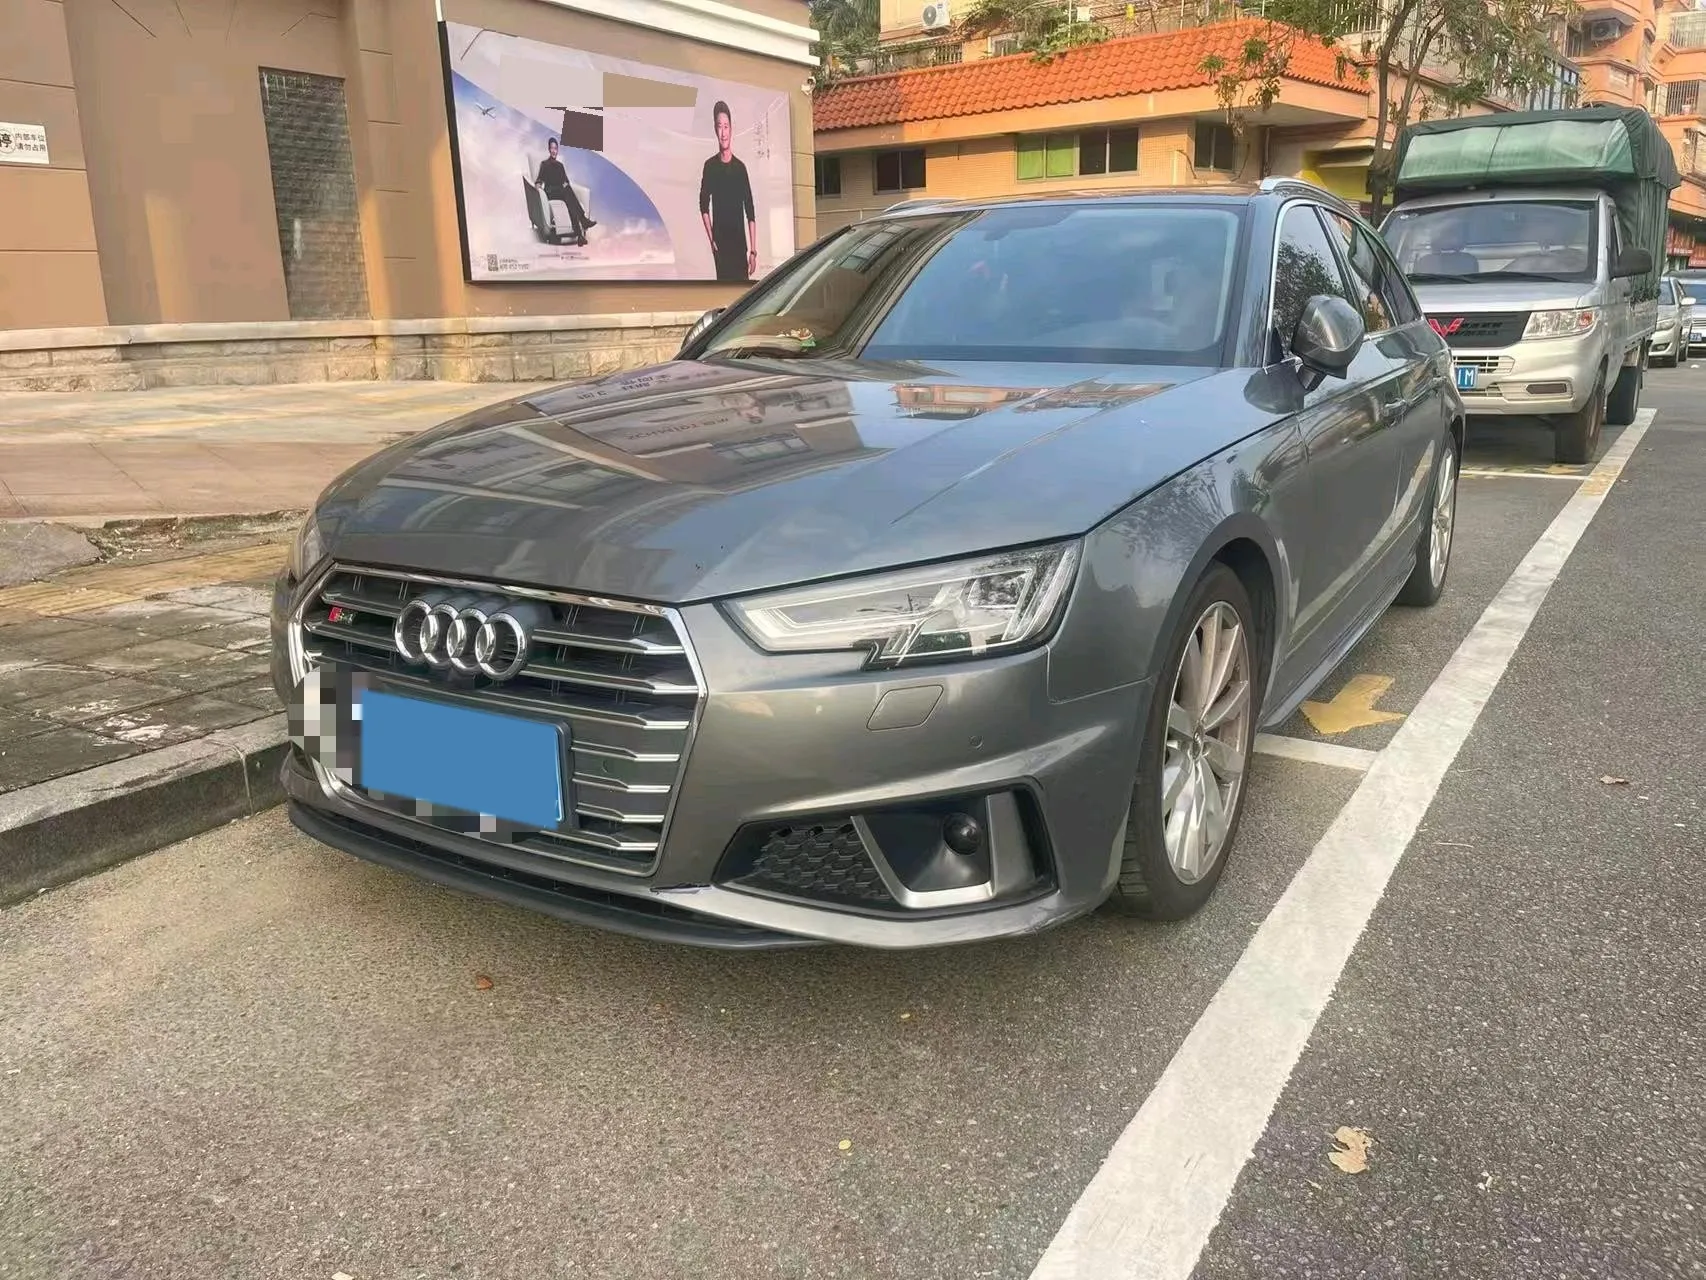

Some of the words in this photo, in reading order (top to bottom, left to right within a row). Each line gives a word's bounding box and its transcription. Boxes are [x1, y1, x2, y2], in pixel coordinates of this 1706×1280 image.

[15, 133, 44, 142] 内部车位
[16, 143, 46, 152] 请勿占用
